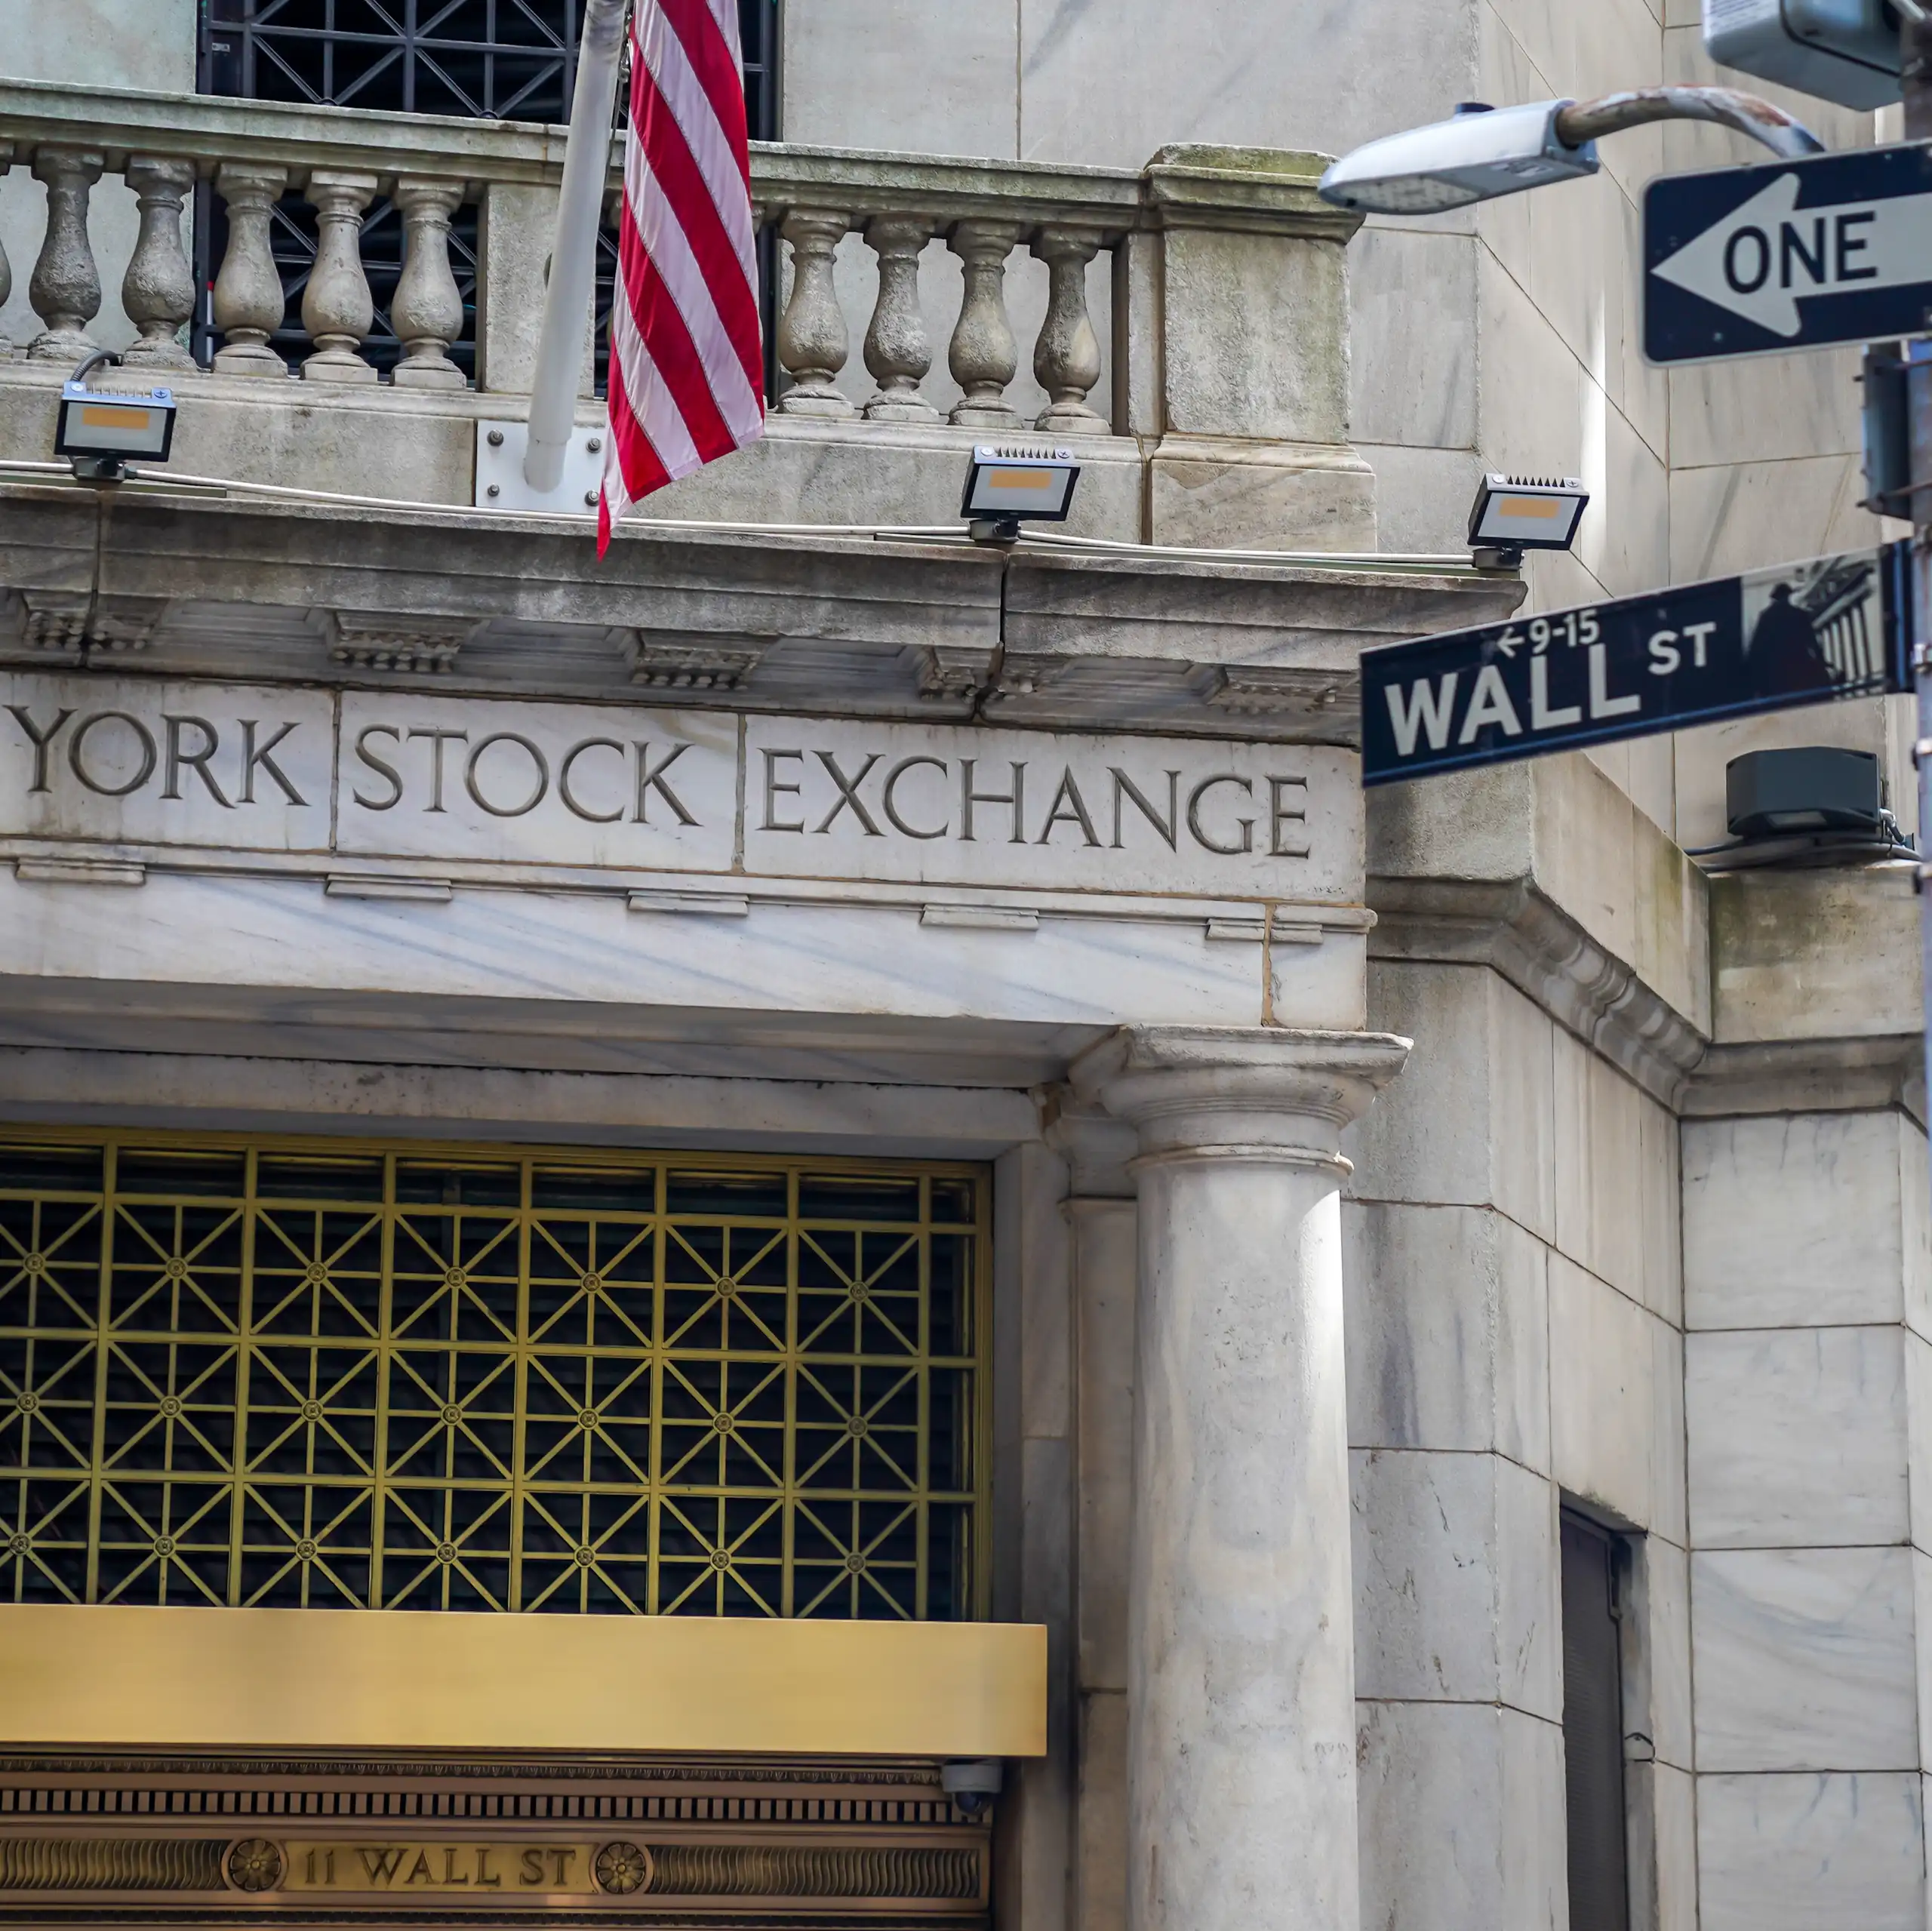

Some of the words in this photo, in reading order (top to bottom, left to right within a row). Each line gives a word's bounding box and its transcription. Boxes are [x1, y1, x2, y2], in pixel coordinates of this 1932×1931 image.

[1723, 211, 1878, 294] ONE
[1529, 610, 1600, 654] 9-15
[1384, 643, 1641, 756] WALL
[1648, 621, 1717, 675] ST
[2, 705, 312, 809] YORK
[353, 724, 703, 827] STOCK
[756, 747, 1310, 859] EXCHANGE
[305, 1847, 337, 1885] 11
[354, 1847, 500, 1886] WALL
[519, 1848, 577, 1886] ST
